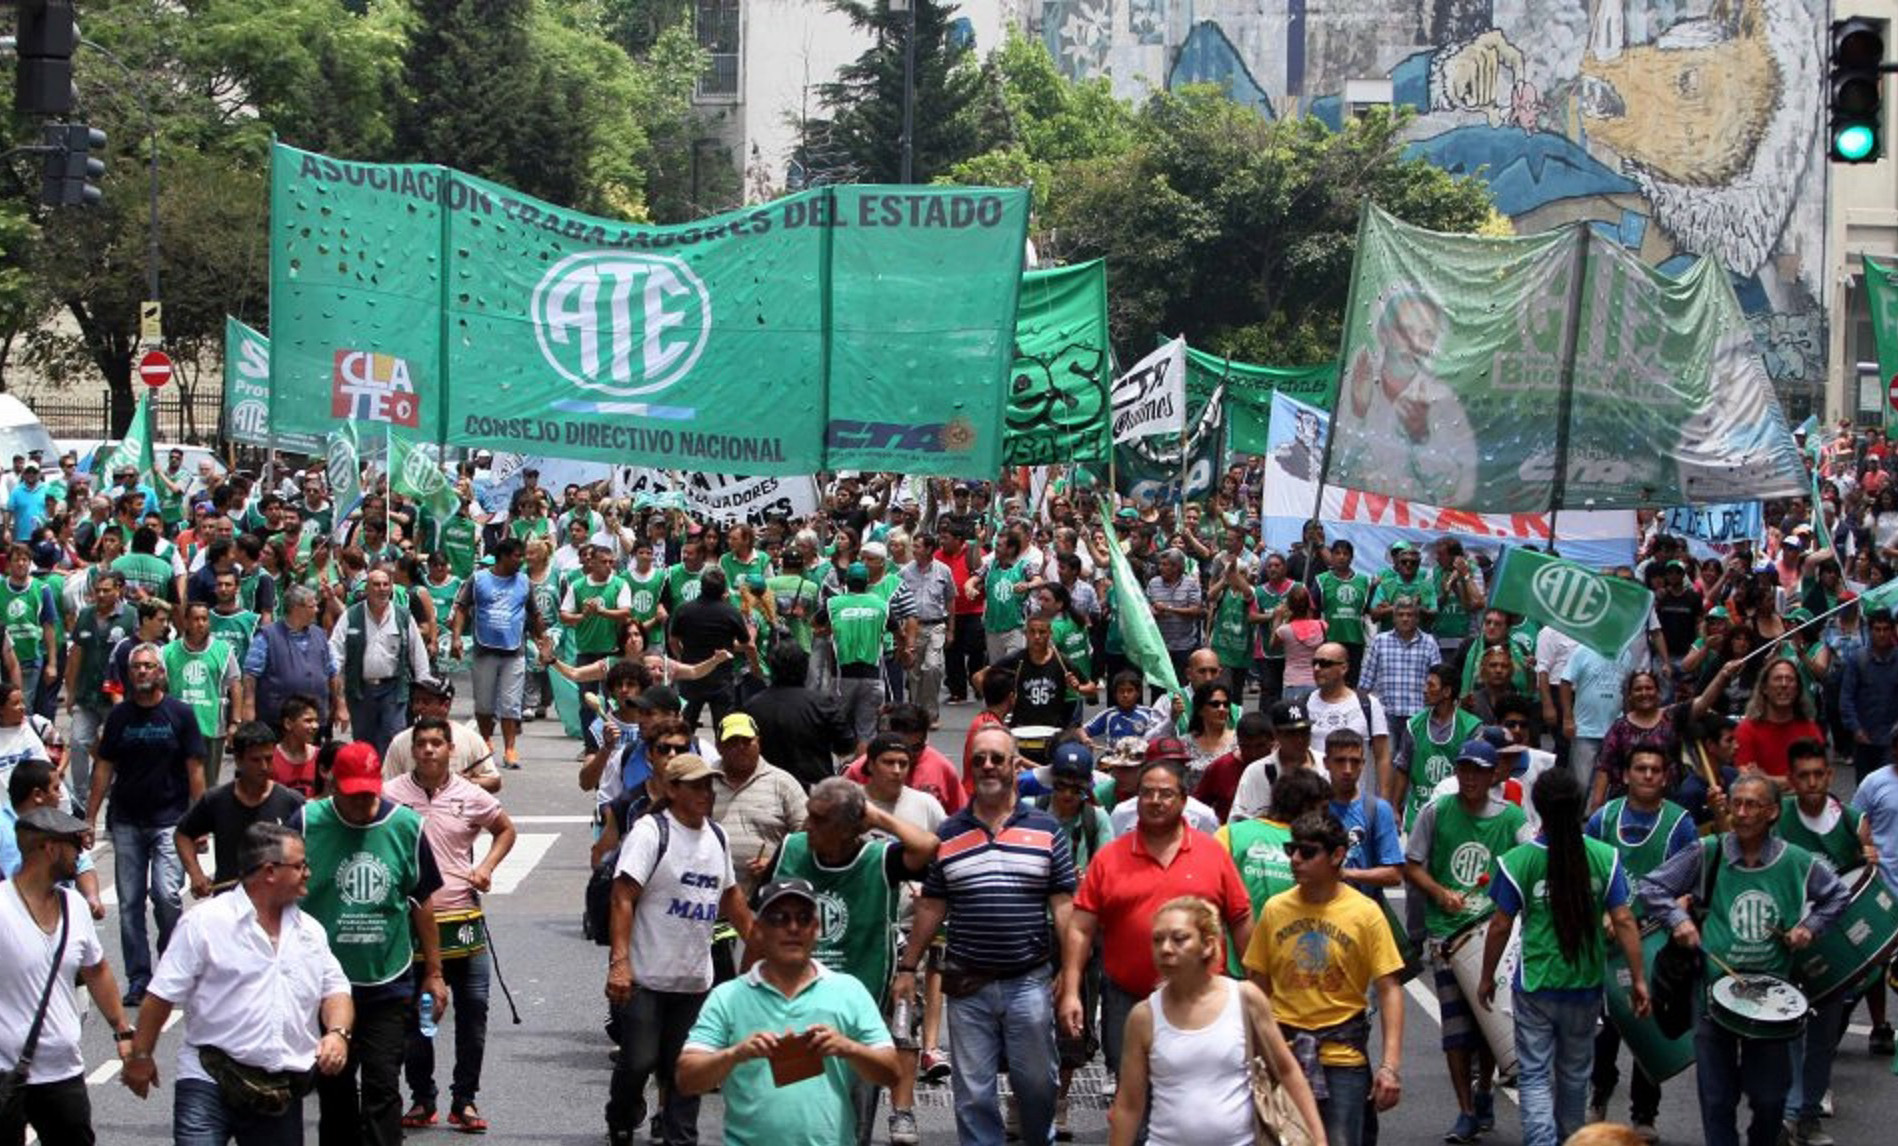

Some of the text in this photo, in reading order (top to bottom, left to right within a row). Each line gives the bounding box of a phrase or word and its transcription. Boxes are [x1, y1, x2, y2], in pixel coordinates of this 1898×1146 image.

[301, 155, 492, 215] ASOCIACION
[784, 194, 848, 229] DEL
[858, 194, 1004, 229] ESTADO
[545, 261, 693, 389] ATE
[340, 351, 414, 394] CLA
[340, 384, 393, 423] TE
[464, 414, 786, 463] CONSEJO DIRECTIVO NACIONAL
[1540, 566, 1604, 620] ATE
[1030, 687, 1050, 704] 95
[344, 864, 384, 902] ATE
[1455, 847, 1489, 885] ATE
[1734, 898, 1773, 941] ATE
